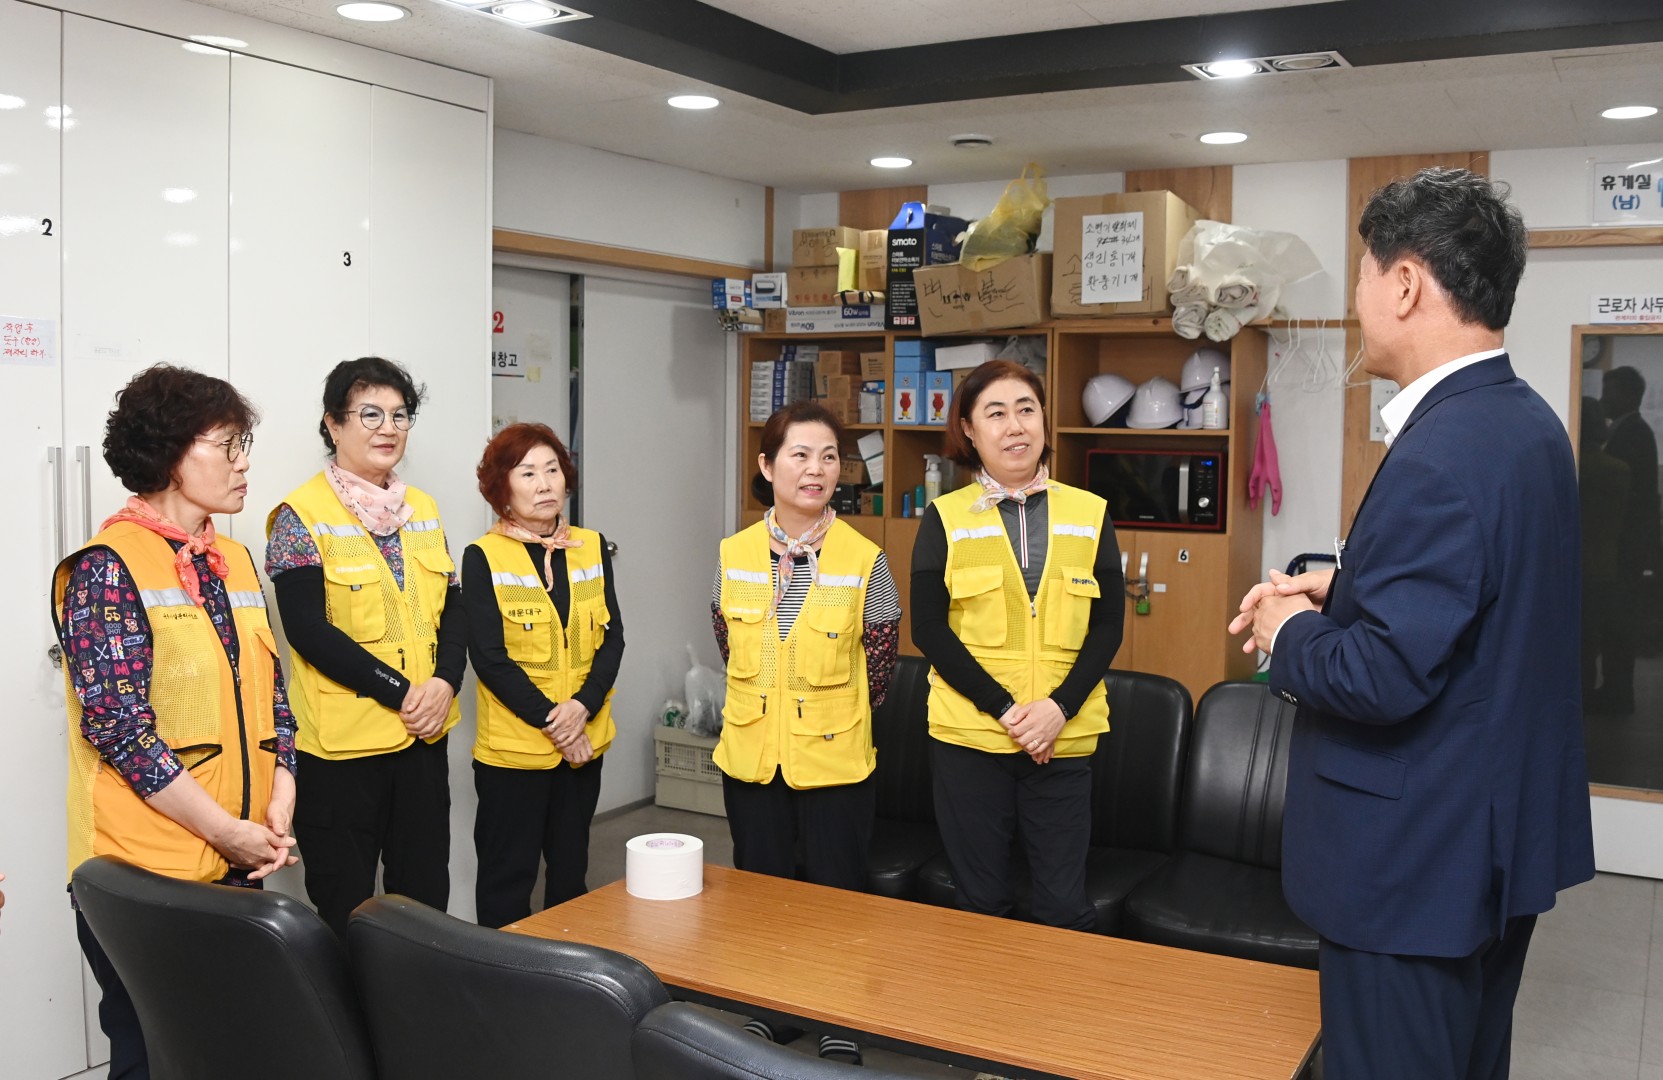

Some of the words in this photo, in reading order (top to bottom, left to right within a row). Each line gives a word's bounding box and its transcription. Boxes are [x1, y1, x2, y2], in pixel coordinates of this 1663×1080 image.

[1600, 174, 1651, 191] 휴게실
[1612, 194, 1641, 210] (남)
[41, 218, 53, 236] 2
[891, 238, 917, 246] smato
[343, 251, 351, 266] 3
[1597, 297, 1637, 313] 근로자
[492, 311, 504, 333] 2
[1180, 549, 1187, 560] 6
[508, 607, 542, 617] 해운대구
[389, 676, 400, 687] K2
